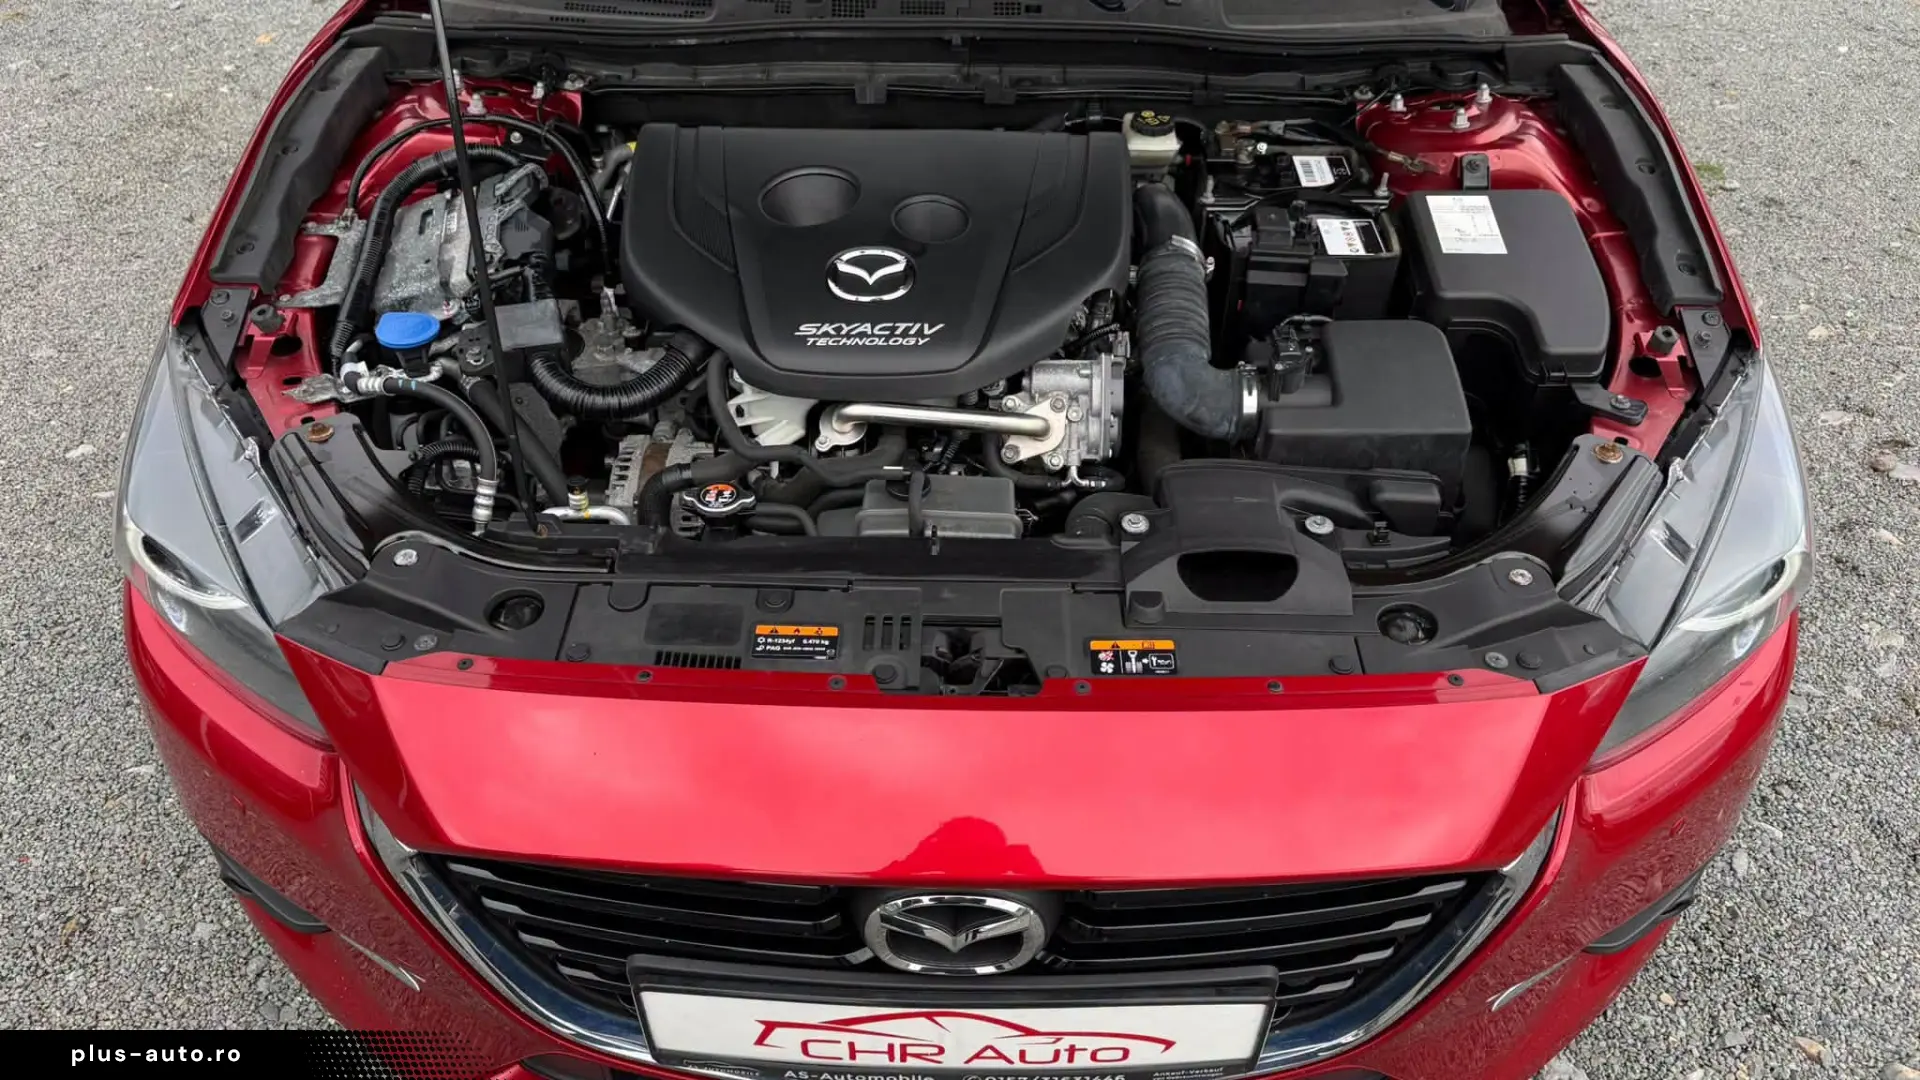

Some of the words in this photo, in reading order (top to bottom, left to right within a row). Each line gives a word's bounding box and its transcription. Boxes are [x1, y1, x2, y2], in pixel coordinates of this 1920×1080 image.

[794, 322, 945, 335] SKYACTIV
[806, 337, 930, 346] TECHNOLOGY
[800, 1039, 946, 1064] CHR
